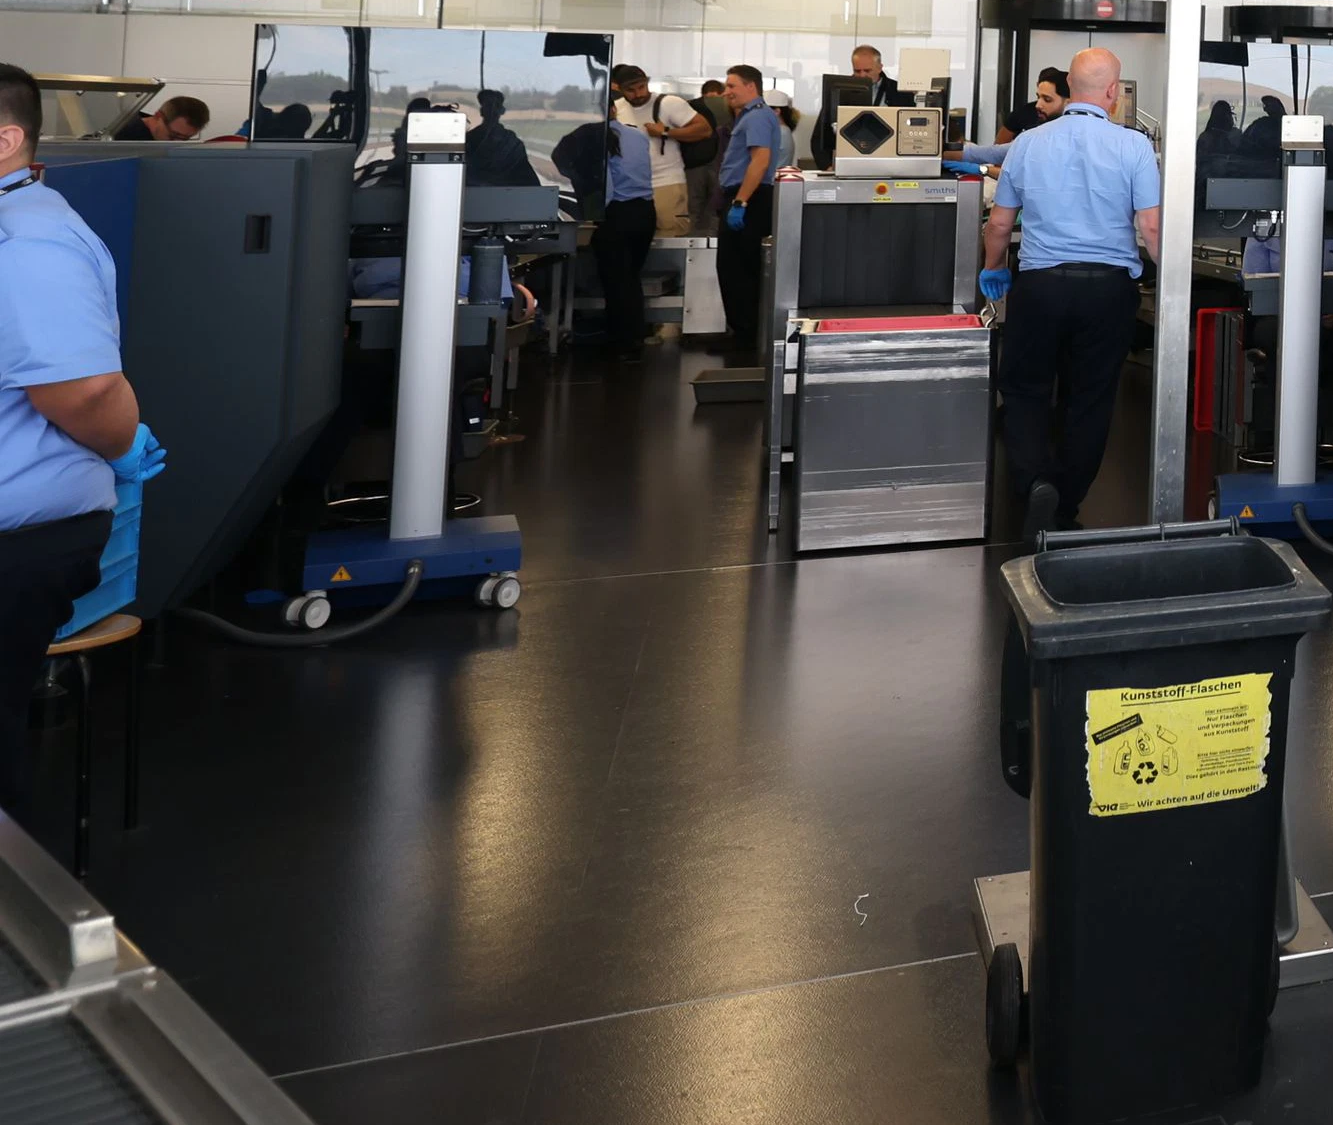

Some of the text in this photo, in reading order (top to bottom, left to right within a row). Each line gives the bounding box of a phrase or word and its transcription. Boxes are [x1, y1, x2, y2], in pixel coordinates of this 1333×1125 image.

[925, 186, 956, 194] smiths
[1120, 681, 1242, 701] Kunststoff-Flaschen
[1220, 712, 1247, 720] Flaschen
[1211, 718, 1256, 729] Verpackungen
[1216, 725, 1249, 735] Kunststoff
[1137, 800, 1154, 808] Wir
[1156, 795, 1187, 807] achten
[1190, 793, 1205, 803] auf
[1206, 790, 1220, 799] die
[1222, 784, 1260, 797] Umwelt!
